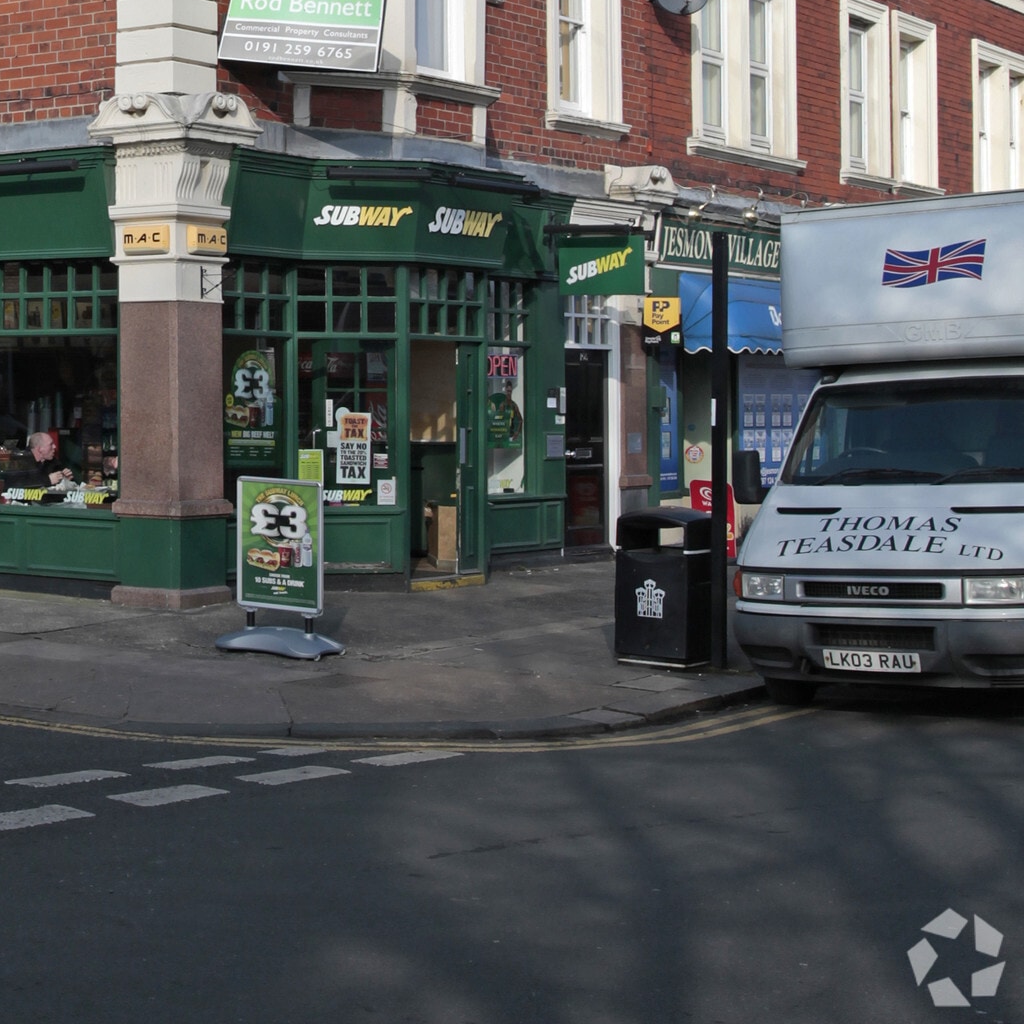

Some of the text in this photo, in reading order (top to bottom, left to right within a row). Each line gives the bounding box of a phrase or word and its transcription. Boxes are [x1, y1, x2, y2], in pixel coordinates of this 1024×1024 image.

[235, 23, 368, 39] Commercial Property Consultants
[244, 40, 353, 59] 0191 259 6765
[313, 205, 413, 226] SUBWAY
[428, 206, 503, 238] SUBWAY
[660, 226, 781, 268] JESMON VILLAGE
[566, 247, 633, 285] SUBWAY
[234, 368, 270, 398] £3
[344, 428, 364, 438] TAX
[340, 466, 366, 478] TAX
[4, 487, 48, 501] SUBWAY
[63, 490, 110, 504] SUBWAY
[323, 489, 372, 502] SUBWAY
[250, 503, 308, 539] £3
[819, 515, 962, 532] THOMAS
[776, 534, 1004, 561] TEASDALE LTD
[847, 586, 889, 596] IVECO
[829, 652, 913, 669] LK03 RAU
